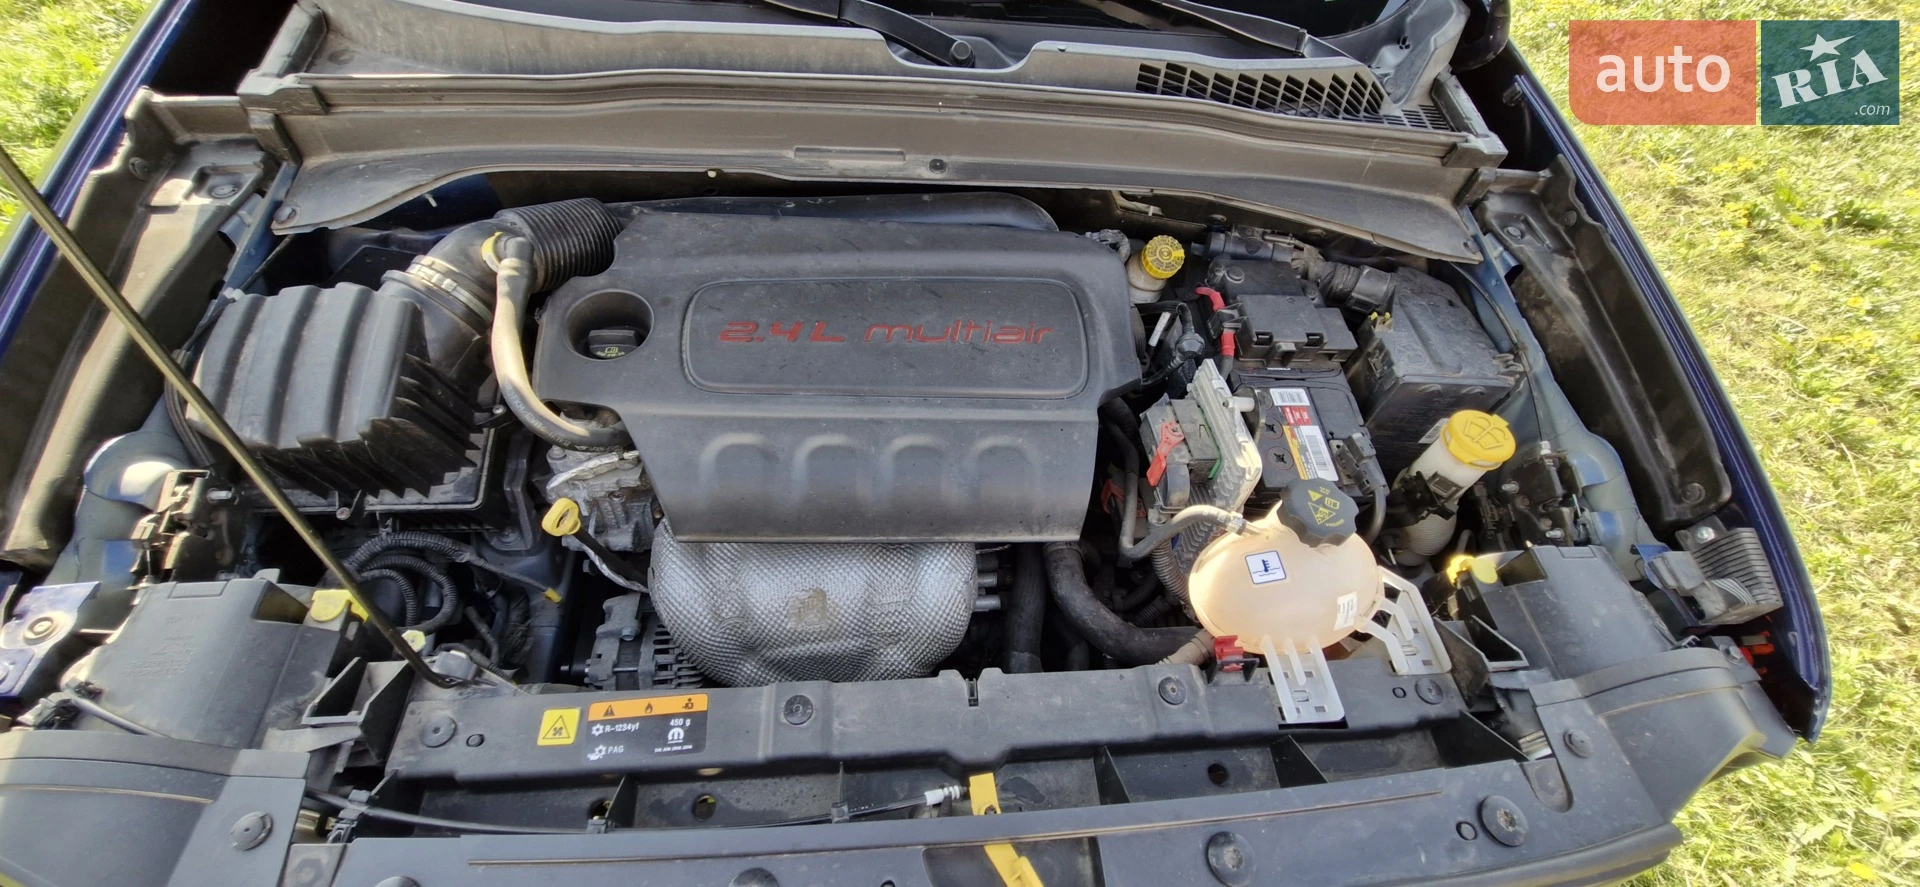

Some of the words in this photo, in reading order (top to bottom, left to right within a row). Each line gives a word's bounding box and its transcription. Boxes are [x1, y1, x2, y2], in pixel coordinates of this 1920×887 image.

[719, 320, 803, 343] 2.4
[810, 320, 846, 343] L
[864, 318, 1055, 346] multiair
[669, 717, 684, 727] 450
[685, 718, 692, 727] g
[605, 723, 639, 733] R-1234yf
[608, 745, 624, 754] PAG
